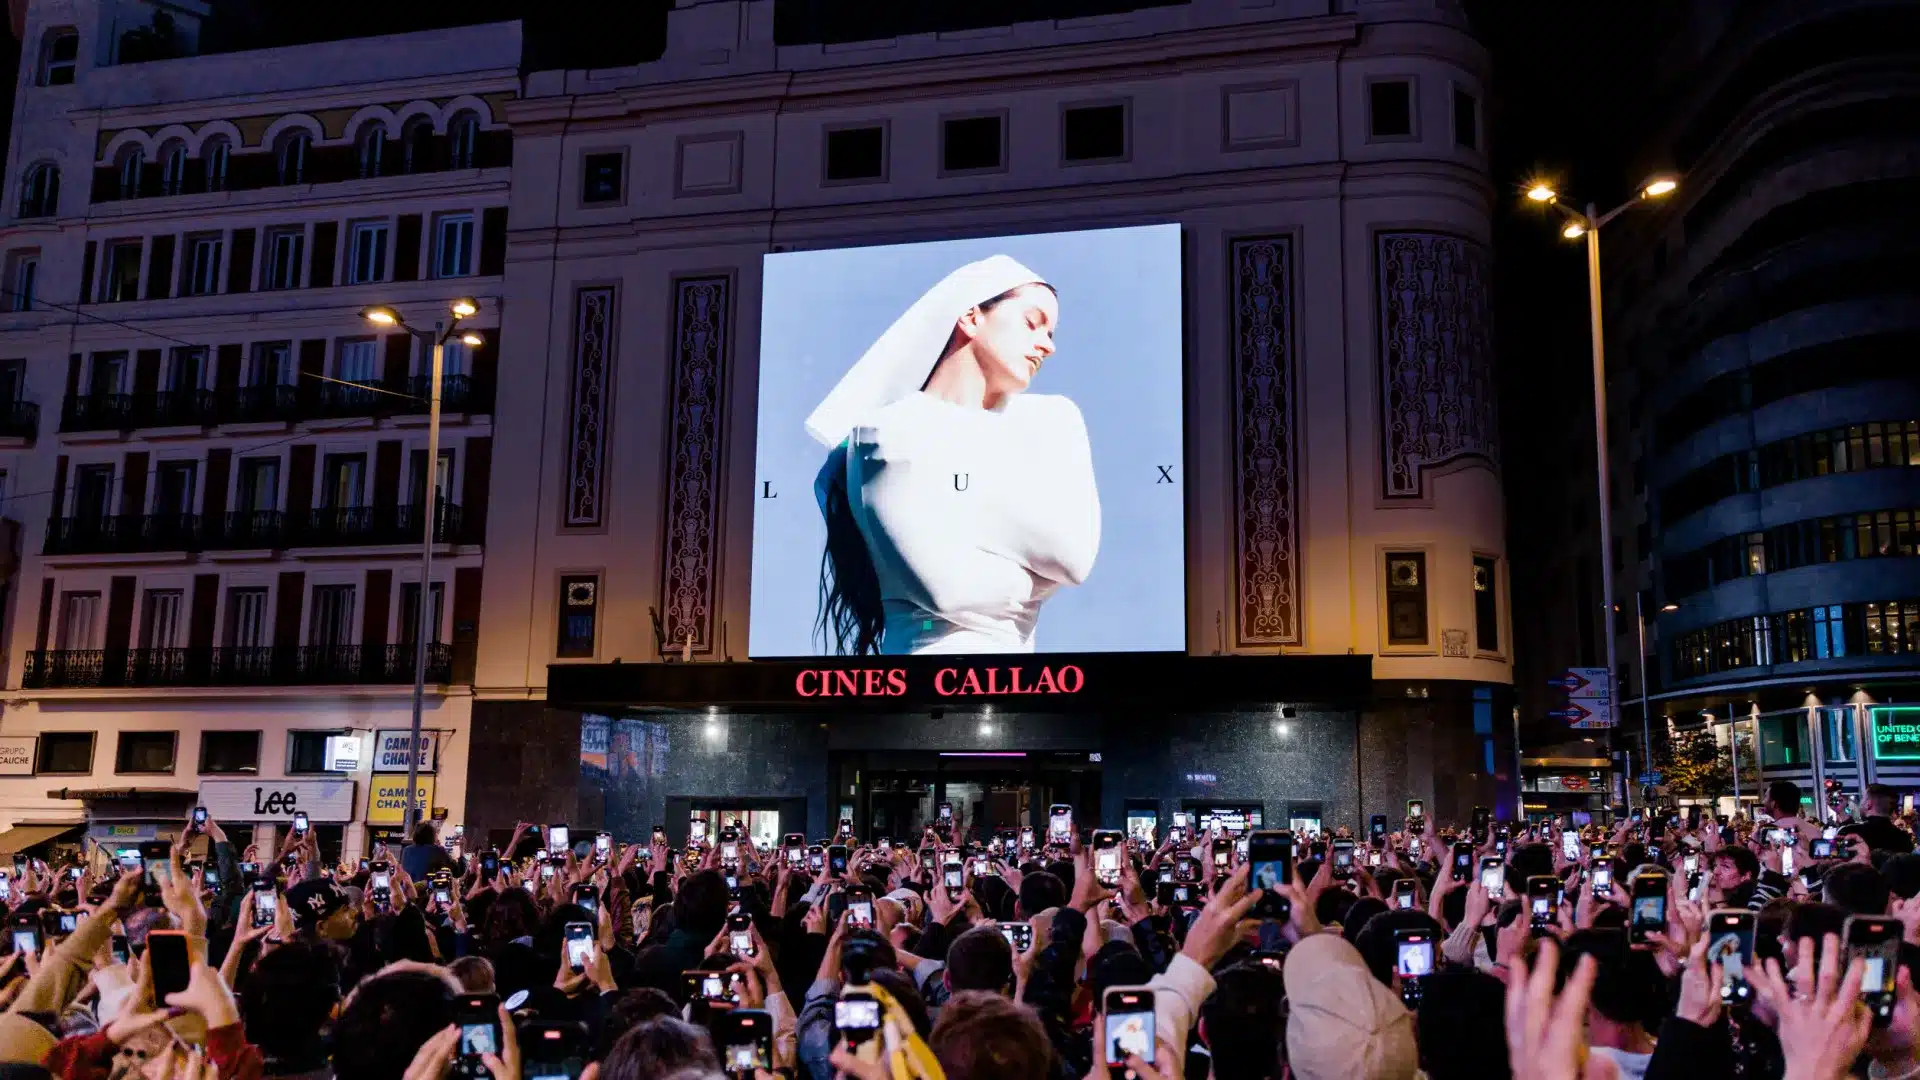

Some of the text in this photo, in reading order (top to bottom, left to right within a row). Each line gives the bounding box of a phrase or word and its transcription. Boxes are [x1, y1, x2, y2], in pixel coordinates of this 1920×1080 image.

[762, 465, 1174, 498] L U X
[795, 665, 1085, 696] CINES CALLAO
[1877, 725, 1914, 733] UNITED
[1878, 734, 1920, 742] OF BENE
[0, 747, 25, 755] GRUPO
[379, 788, 426, 797] CAMO
[254, 787, 297, 815] Lee
